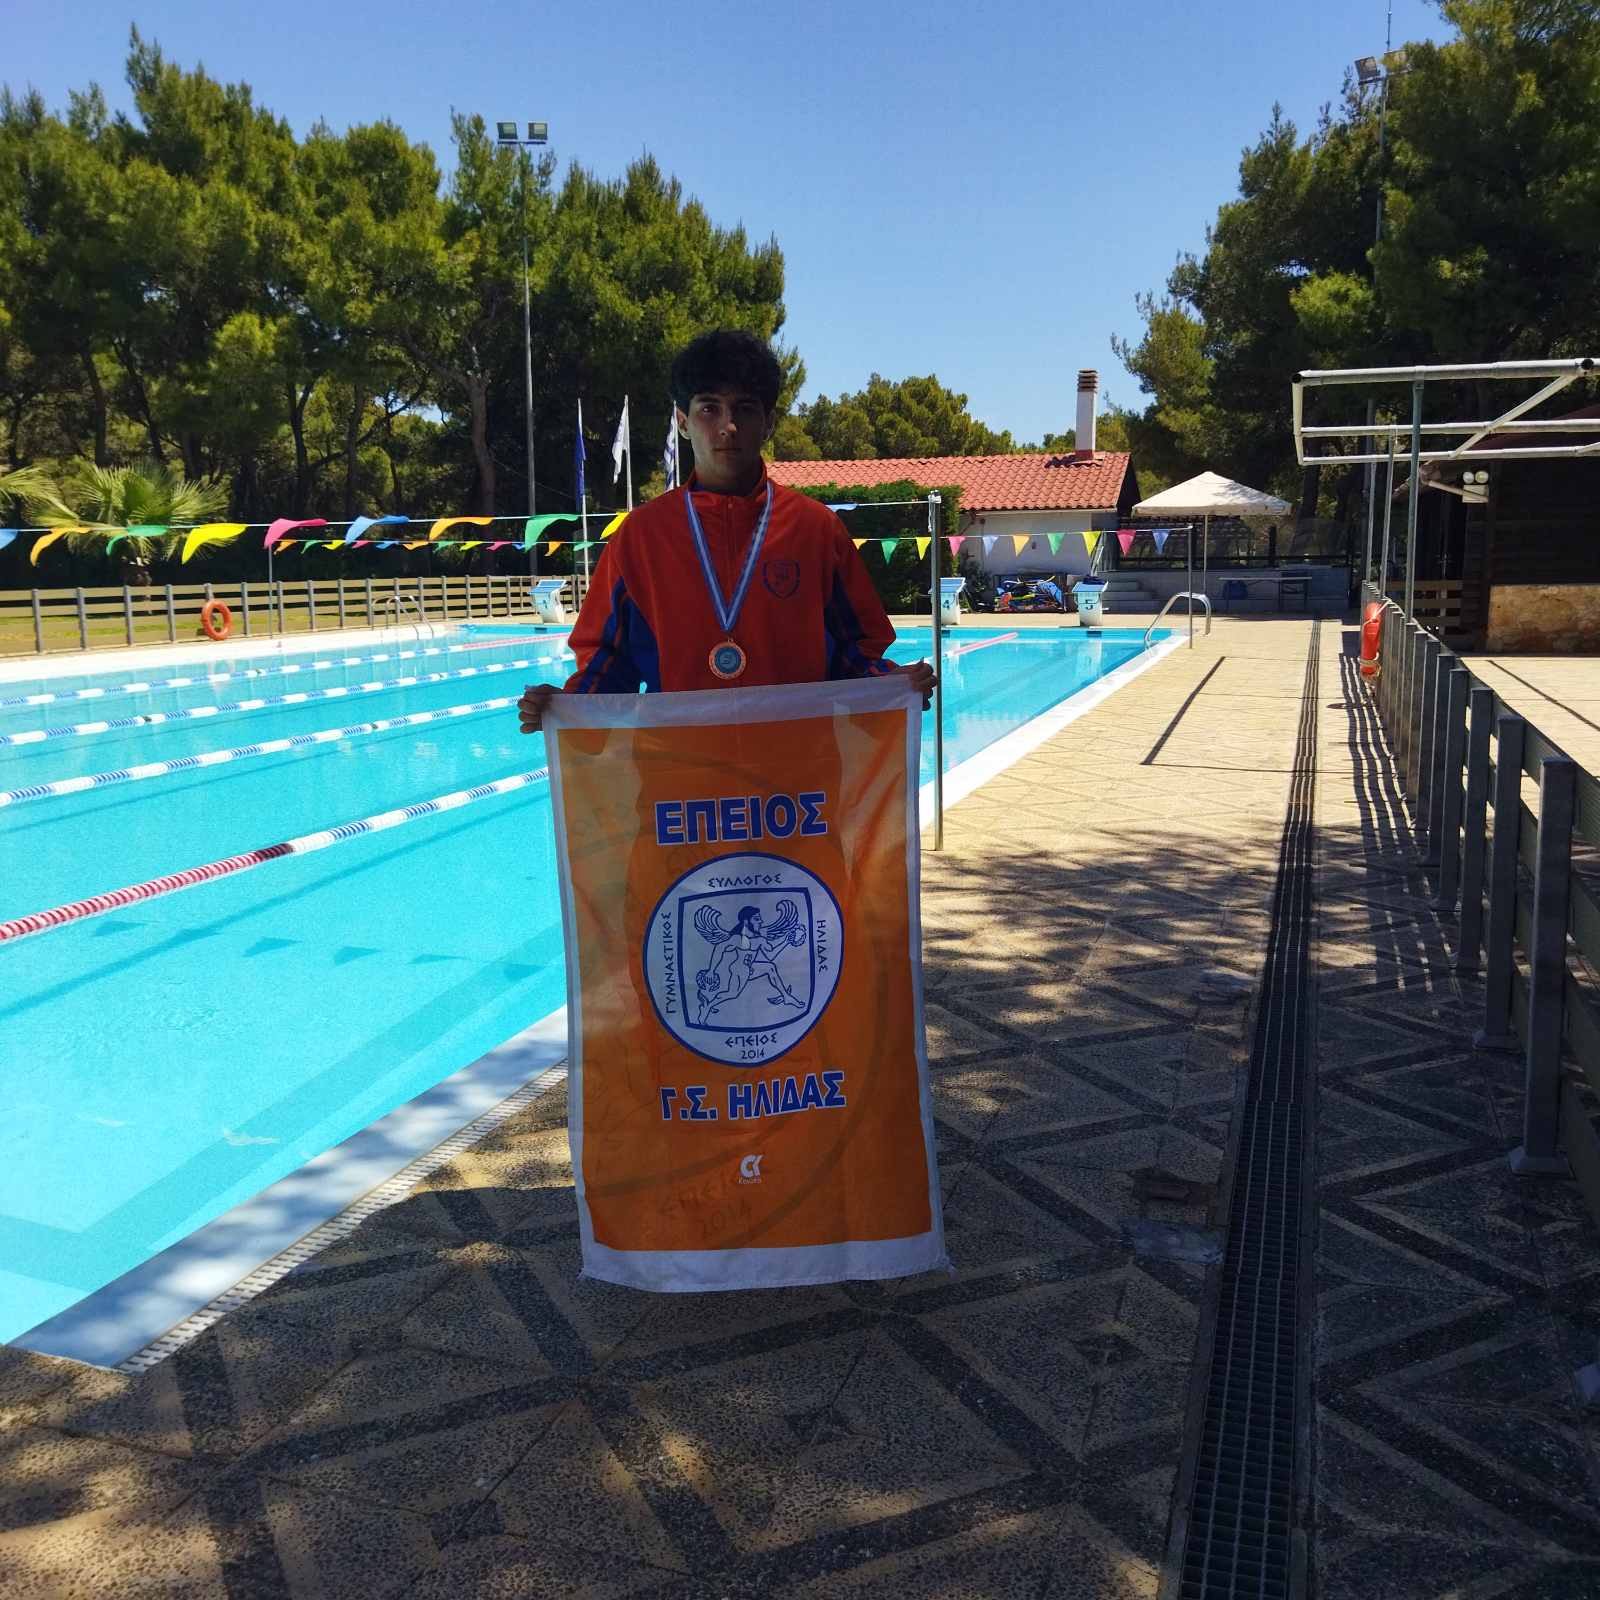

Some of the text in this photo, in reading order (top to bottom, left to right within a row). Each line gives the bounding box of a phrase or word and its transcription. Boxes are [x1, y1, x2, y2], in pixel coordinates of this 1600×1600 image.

[942, 599, 950, 610] 4
[1085, 599, 1094, 610] 5
[654, 791, 828, 846] ΕΠΕΙΟΣ
[707, 873, 783, 888] ΣΥΛΛΟΓΟΣ
[816, 919, 829, 973] ΗΛΙΔΑΣ
[660, 911, 677, 1014] ΓΥΜΝΑΣΤΙΚΟΣ
[725, 1032, 778, 1048] ΕΠΕΙΟΣ
[741, 1049, 765, 1060] 2014
[659, 1070, 847, 1121] Γ.Σ. ΗΛΙΔΑΣ
